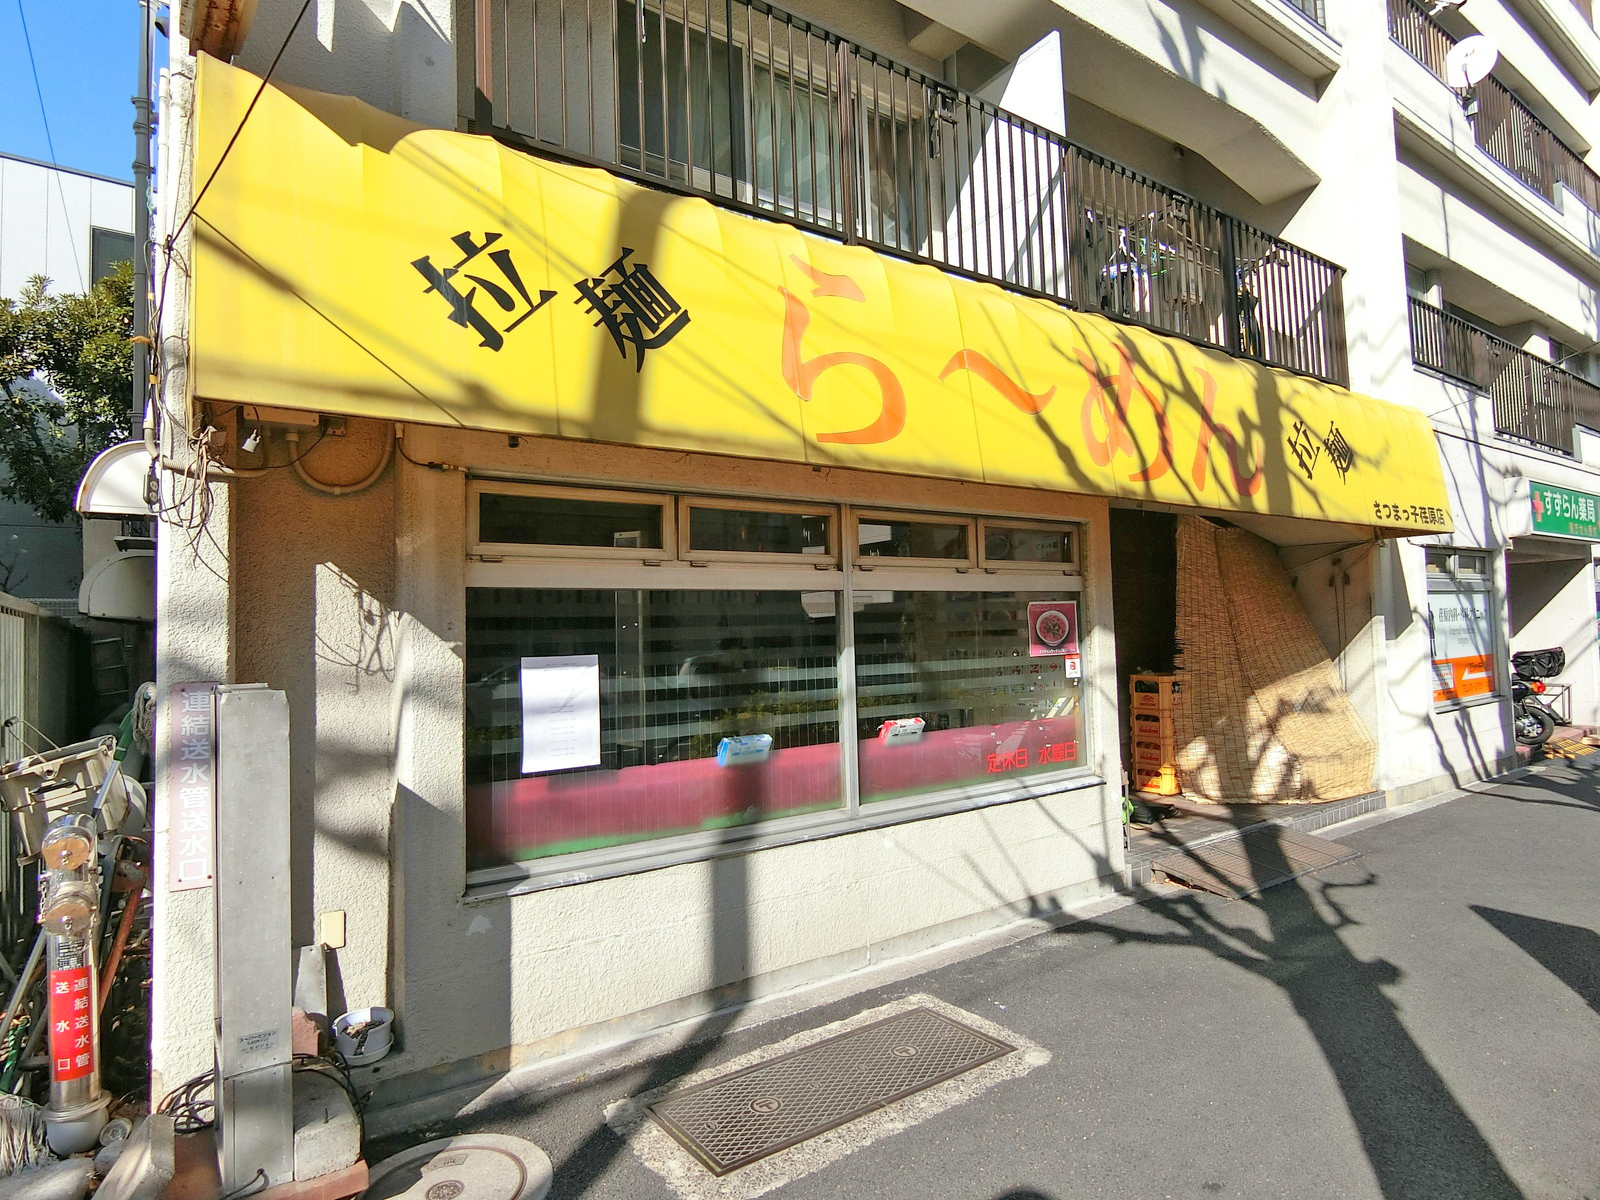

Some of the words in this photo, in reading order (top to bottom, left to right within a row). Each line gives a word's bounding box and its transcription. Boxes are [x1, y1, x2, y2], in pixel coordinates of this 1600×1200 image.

[1373, 500, 1445, 526] さつまっ子荏原店
[1543, 490, 1595, 523] すずらん薬局
[179, 690, 210, 881] 連結送水管送水口
[987, 748, 1028, 773] 定休日
[1038, 742, 1077, 764] 水曜日
[55, 981, 71, 1070] 送水口
[74, 977, 90, 1068] 連結送水管
